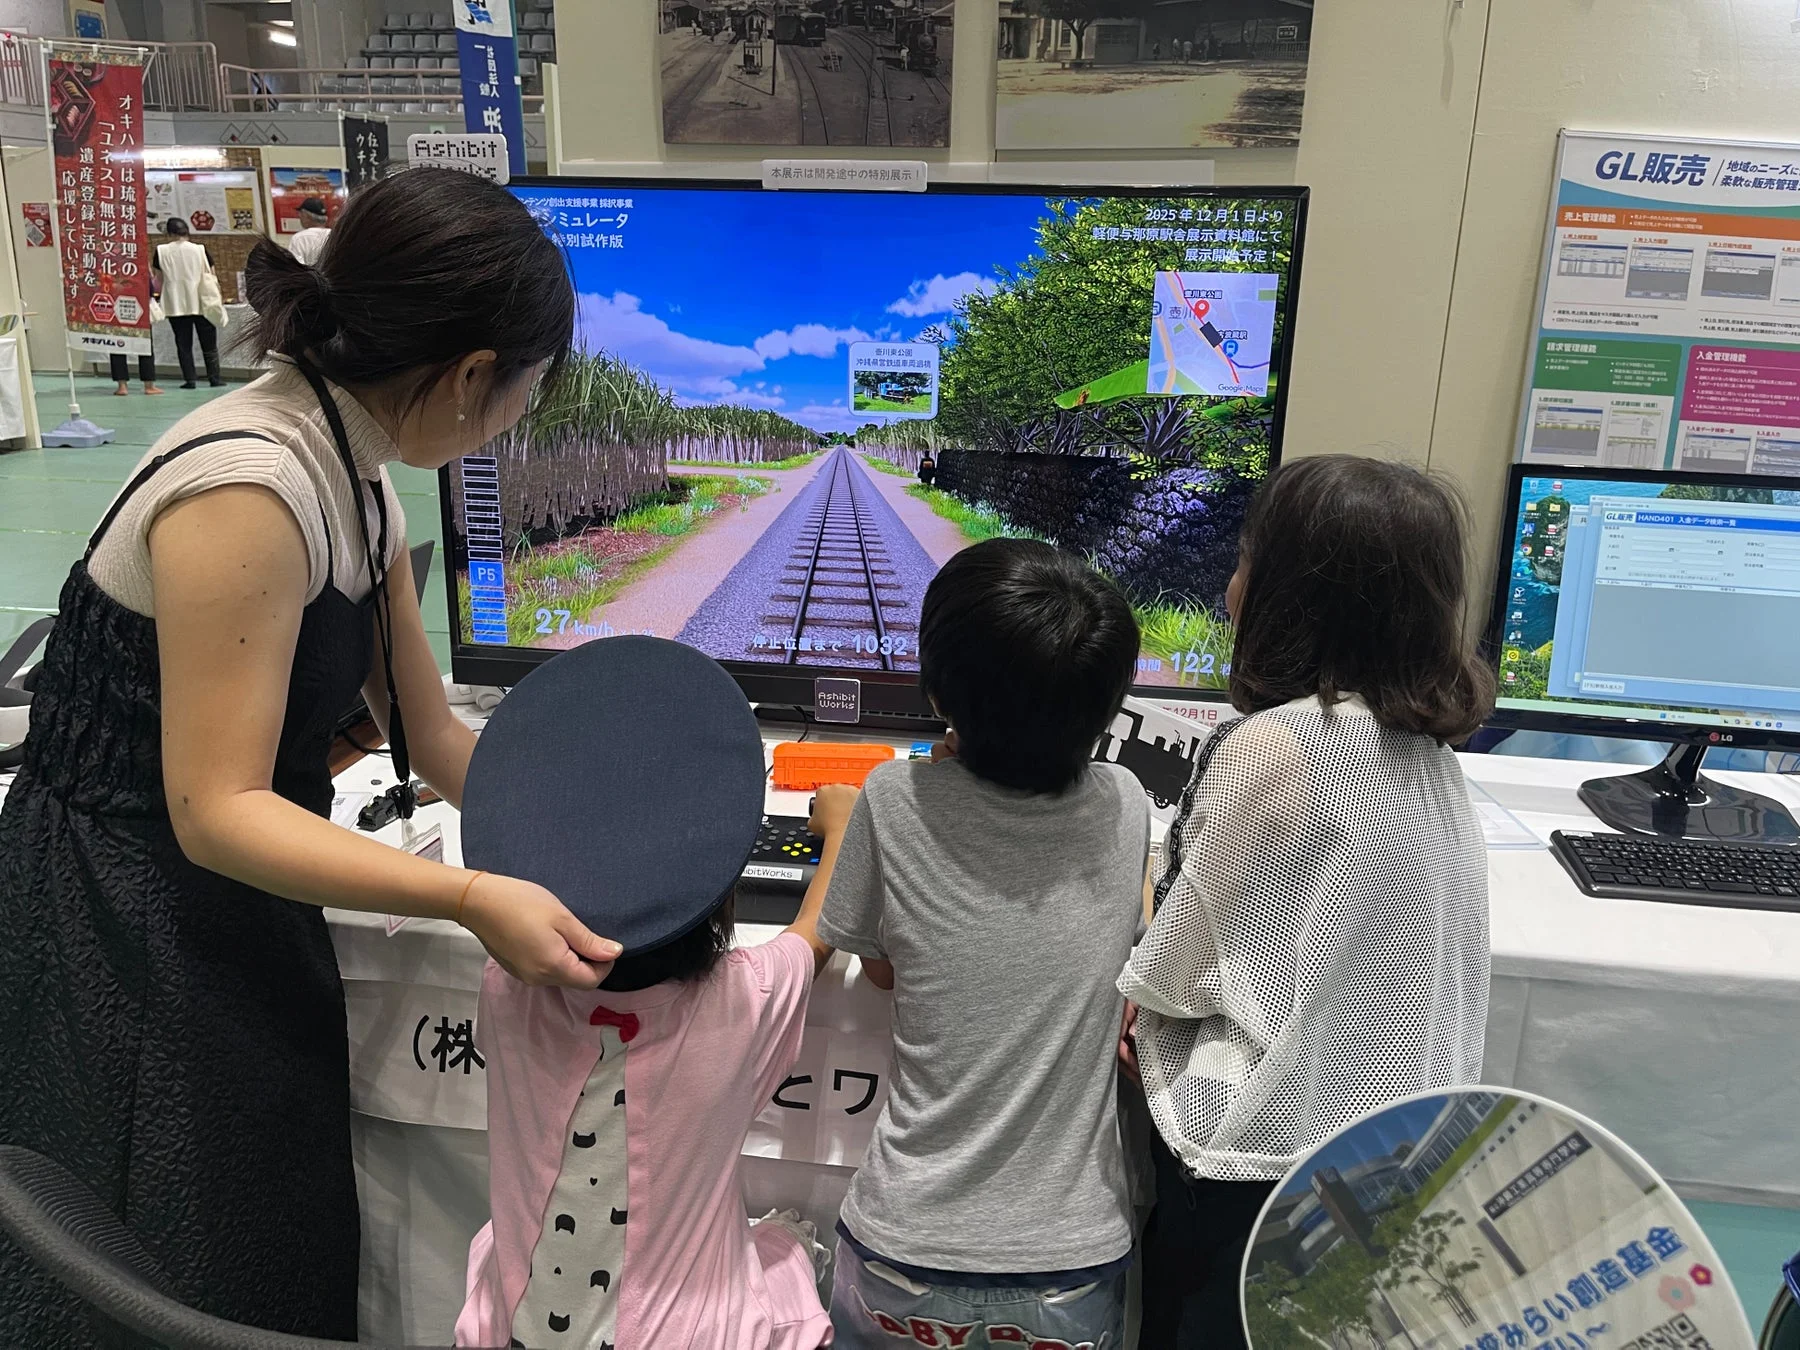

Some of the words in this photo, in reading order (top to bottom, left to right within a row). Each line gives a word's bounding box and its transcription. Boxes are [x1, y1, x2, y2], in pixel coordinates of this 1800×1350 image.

[415, 140, 497, 157] Ashibit
[771, 167, 920, 181] 本展示は開発途中の特別展示！
[1595, 150, 1711, 187] GL販売
[119, 94, 138, 277] オキハムは琉球料理の
[1720, 175, 1800, 191] 柔軟な販売管理
[98, 121, 117, 275] 「ユネスコ無形文化
[80, 147, 97, 287] 遺産登録」活動を
[62, 170, 79, 299] 応援しています
[1093, 227, 1282, 242] 軽便与那原駅舎展示資料館にて
[1218, 383, 1242, 393] Google
[1638, 514, 1674, 523] HAND401
[477, 567, 496, 581] P5
[536, 608, 571, 635] 27
[574, 619, 614, 636] km/h
[852, 633, 907, 656] 1032
[1171, 651, 1214, 673] 122
[818, 691, 856, 702] Ashibit
[819, 700, 855, 710] Works
